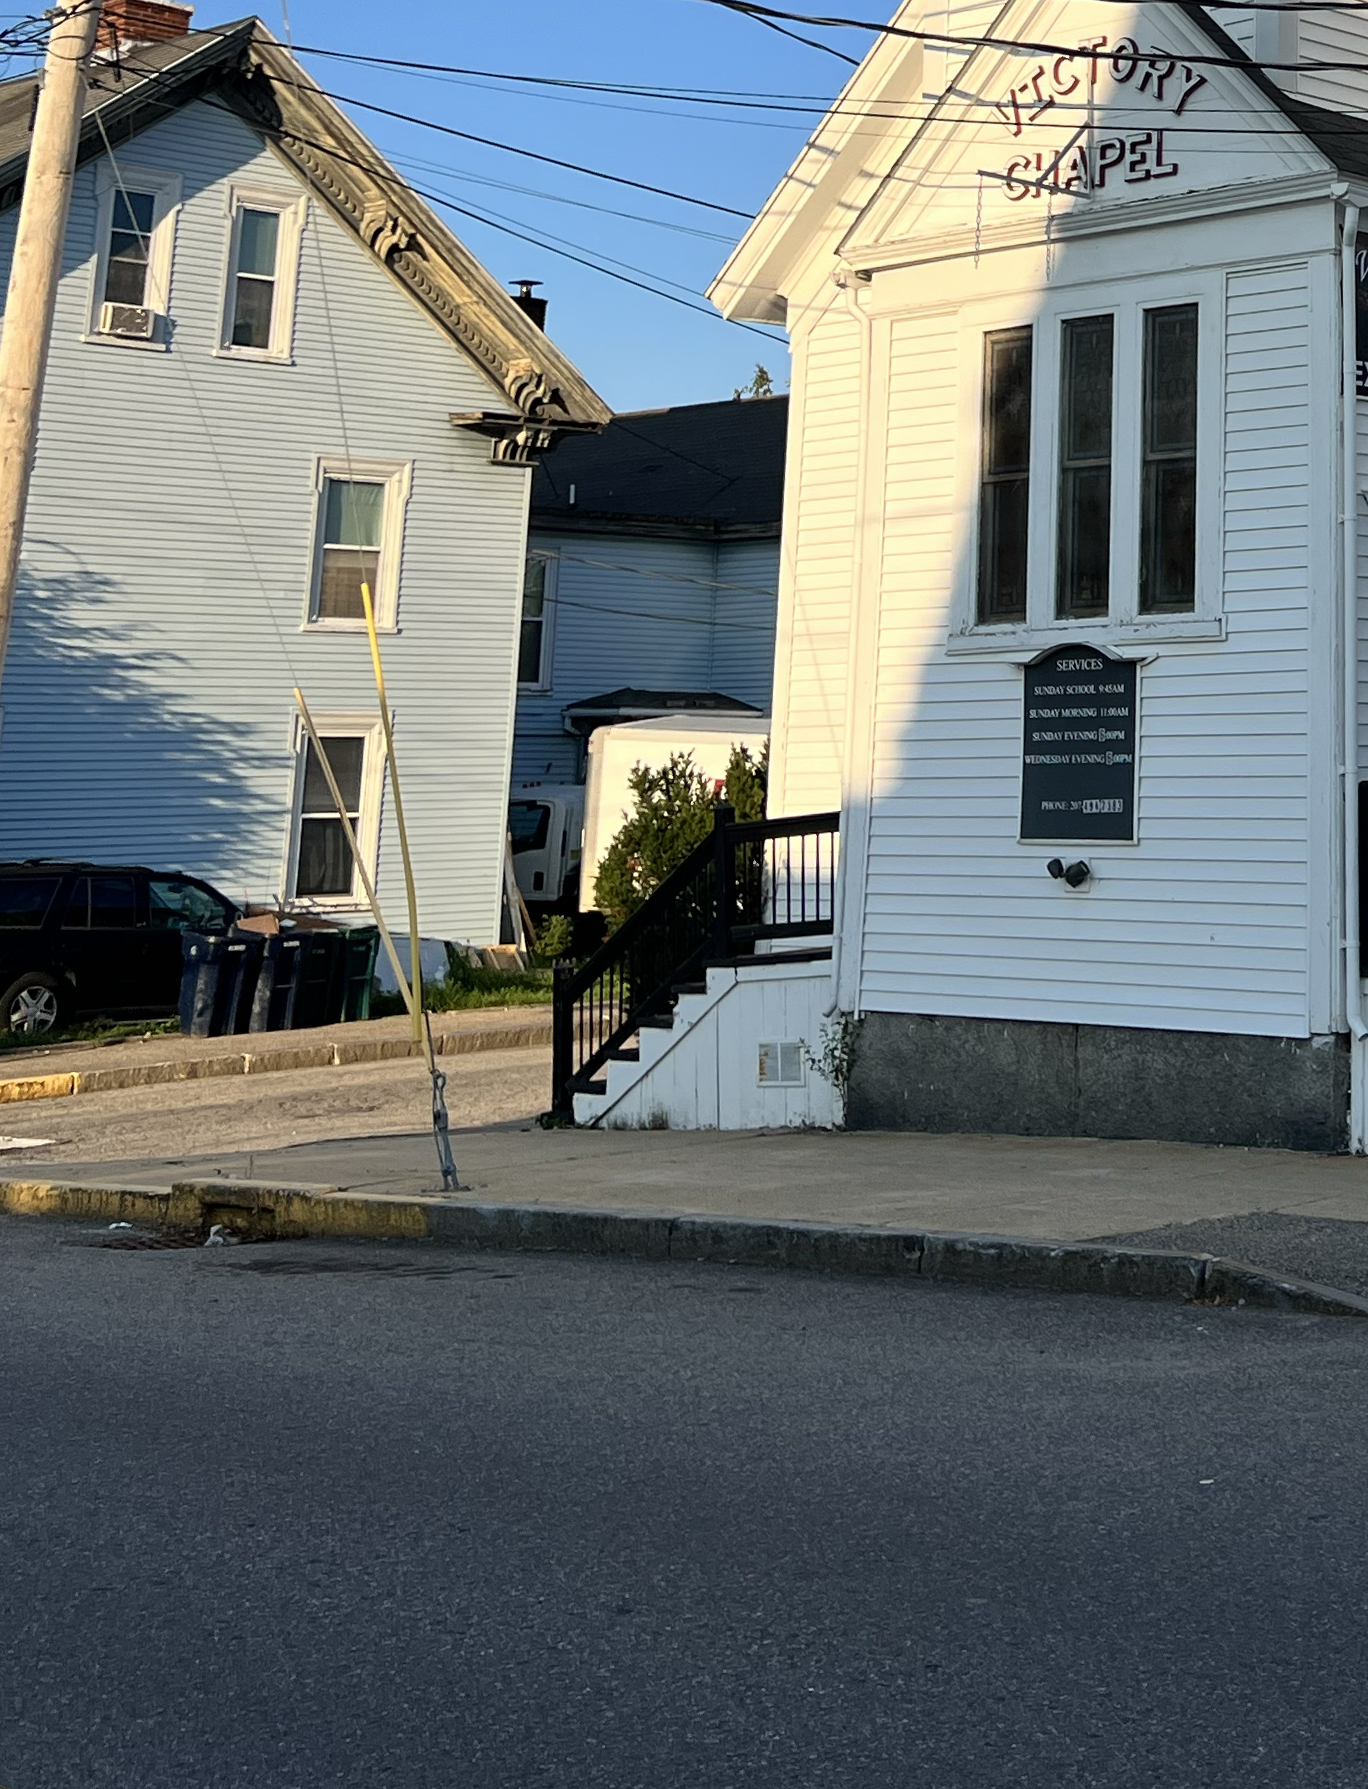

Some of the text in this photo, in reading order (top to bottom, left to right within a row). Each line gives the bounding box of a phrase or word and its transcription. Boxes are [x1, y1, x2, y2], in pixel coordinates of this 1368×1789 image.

[994, 35, 1207, 138] VICTORY
[1001, 130, 1178, 201] CHAPEL
[1056, 658, 1103, 671] SERVICES
[1034, 685, 1064, 696] SUNDAY
[1066, 684, 1096, 695] SCHOOL
[1029, 708, 1060, 719] SUNDAY
[1061, 707, 1097, 718] MORNING
[1032, 730, 1063, 741] SUNDAY
[1064, 729, 1098, 740] EVENING
[1024, 753, 1071, 764] WEDNESDAY
[1071, 753, 1105, 764] EVENING
